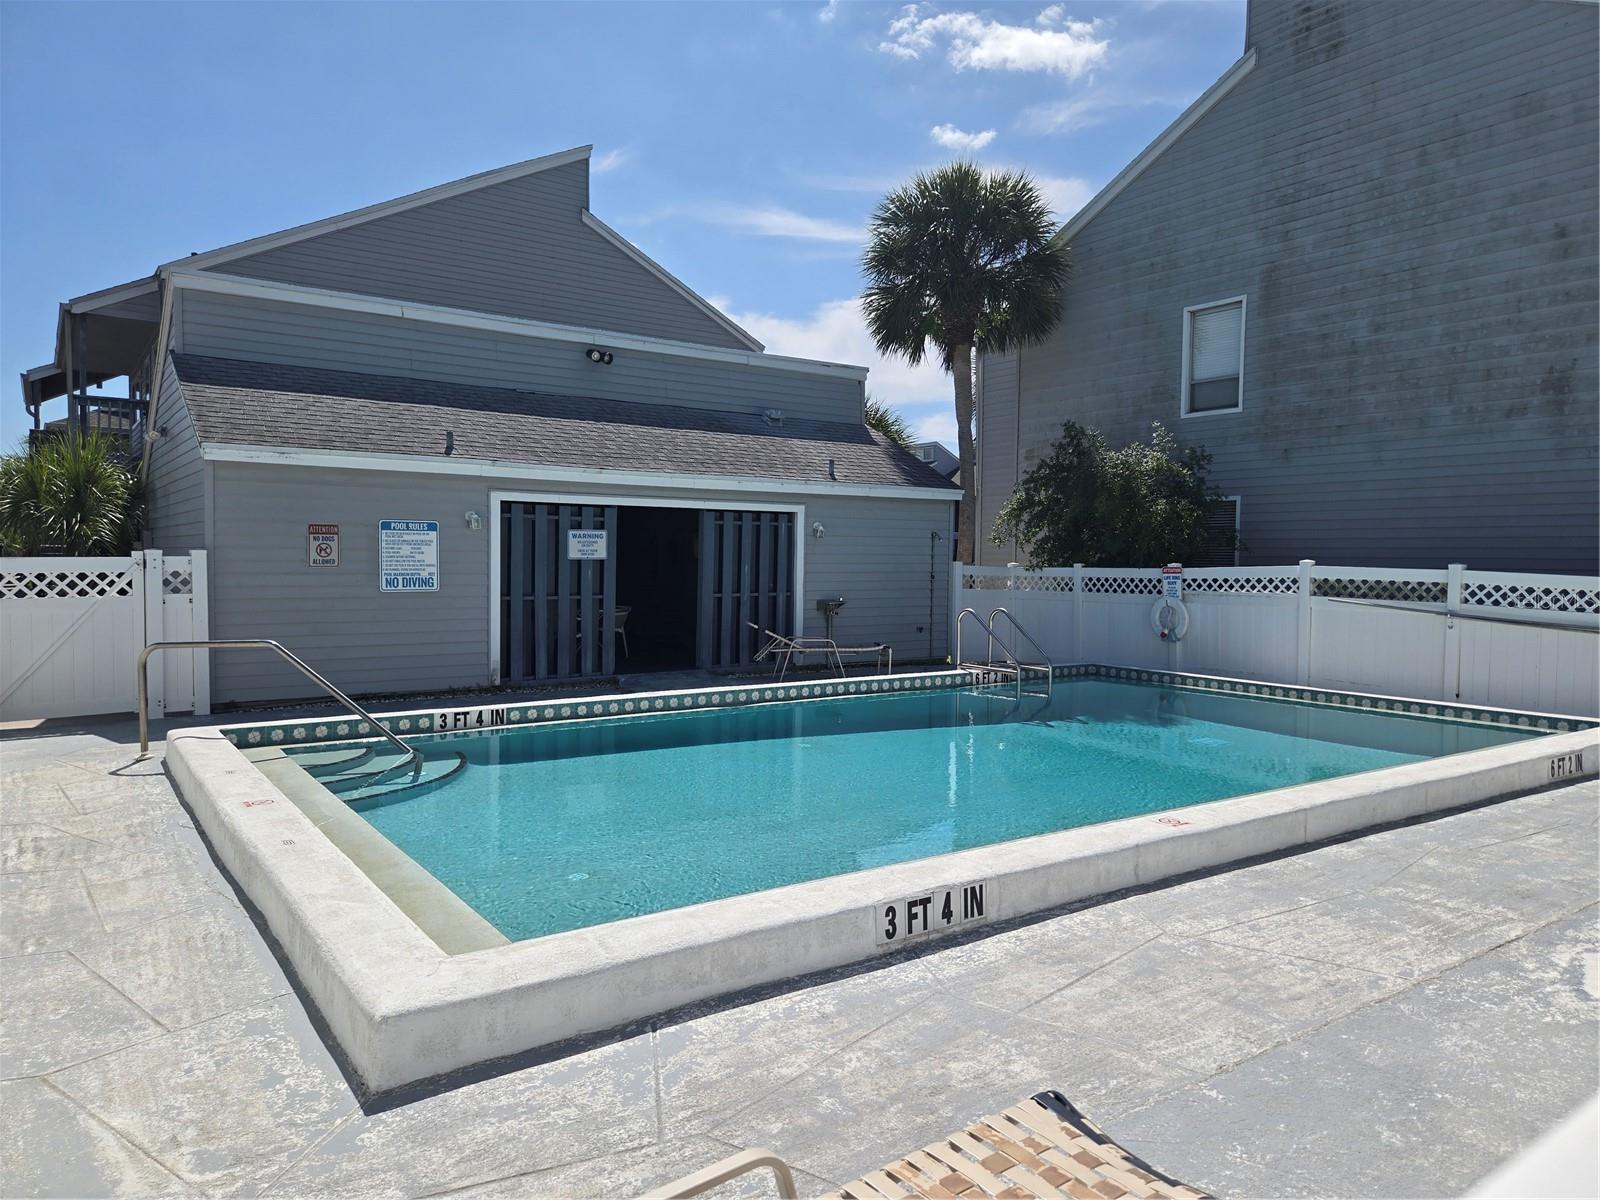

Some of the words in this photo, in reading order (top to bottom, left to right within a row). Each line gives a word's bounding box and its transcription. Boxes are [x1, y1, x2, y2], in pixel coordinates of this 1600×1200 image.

[309, 525, 338, 533] ATTENTION
[391, 522, 407, 530] POOL
[385, 577, 399, 588] NO
[402, 576, 435, 588] DIVING
[976, 673, 980, 684] 6
[982, 672, 991, 684] FT
[994, 672, 999, 683] 2
[1002, 673, 1008, 683] IN
[439, 713, 448, 729] 3
[453, 711, 470, 728] FT
[475, 710, 484, 726] 4
[490, 709, 505, 725] IN
[1550, 759, 1556, 778] 6
[1557, 757, 1566, 777] FT
[1568, 755, 1573, 774] 2
[1574, 753, 1584, 772] IN
[884, 905, 897, 940] 3
[907, 896, 932, 935] FT
[941, 891, 953, 925] 4
[963, 883, 984, 920] IN
